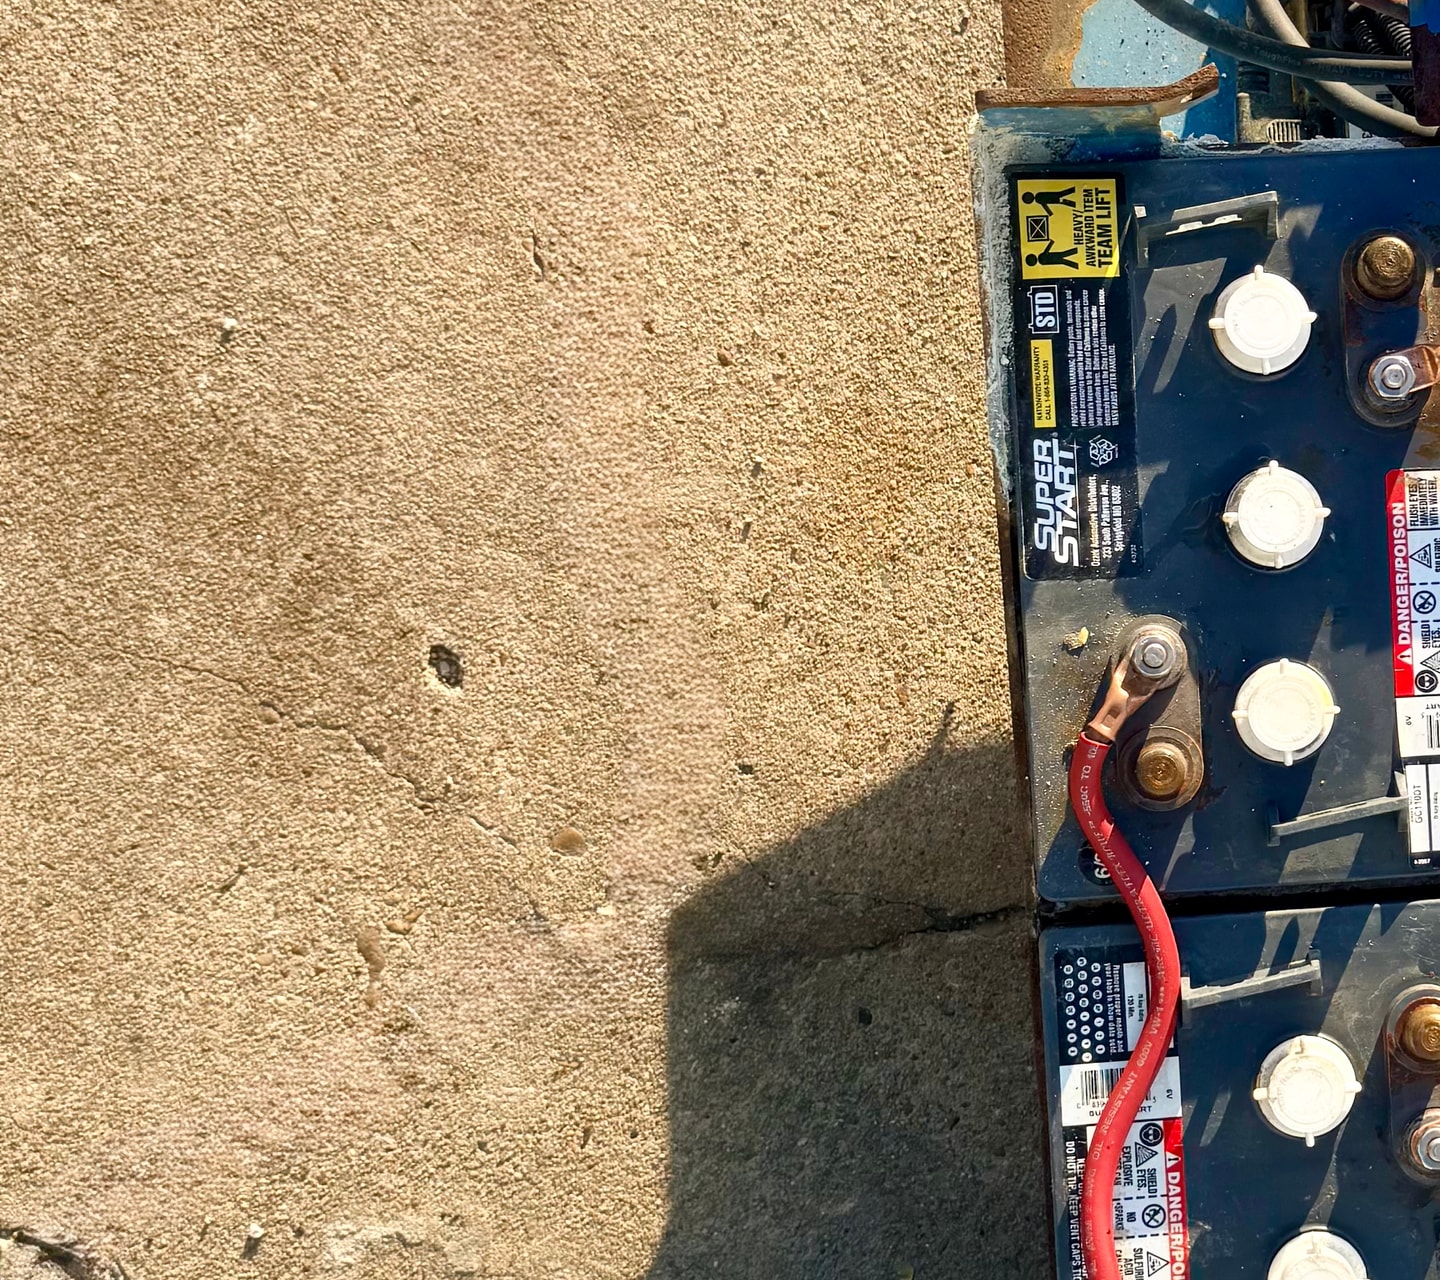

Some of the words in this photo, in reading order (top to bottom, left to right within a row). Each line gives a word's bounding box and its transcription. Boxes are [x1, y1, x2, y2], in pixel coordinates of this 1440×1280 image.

[1083, 189, 1094, 213] ITEM
[1094, 188, 1112, 219] LIFT
[1072, 210, 1084, 245] HEAVY/
[1084, 216, 1097, 267] AWKWARD
[1095, 223, 1113, 268] TEAM
[1035, 292, 1056, 327] STD
[1033, 439, 1056, 552] SUPER
[1052, 439, 1079, 566] START
[1408, 484, 1417, 502] EYES
[1418, 478, 1429, 526] IMMEDIATELY
[1100, 496, 1111, 526] Patterson
[1409, 504, 1418, 527] FLUSH
[1429, 507, 1438, 525] WITH
[1087, 513, 1099, 548] Automotive
[1101, 527, 1112, 545] South
[1089, 549, 1100, 566] Ozark
[1392, 502, 1411, 645] DANGER/POISON
[1421, 624, 1431, 649] SHIELD
[1432, 628, 1440, 648] EYES.
[1405, 716, 1412, 725] 6V
[1100, 1072, 1139, 1136] RESISTANT
[1166, 1089, 1173, 1099] 6V
[1065, 1141, 1075, 1154] DO
[1066, 1156, 1076, 1174] NOT
[1122, 1146, 1133, 1186] EXPLOSIVE
[1067, 1176, 1076, 1192] TIP.
[1136, 1169, 1146, 1190] EYES.
[1147, 1168, 1157, 1193] SHIELD
[1068, 1194, 1078, 1216] KEEP
[1070, 1219, 1080, 1240] VENT
[1071, 1243, 1081, 1265] CAPS
